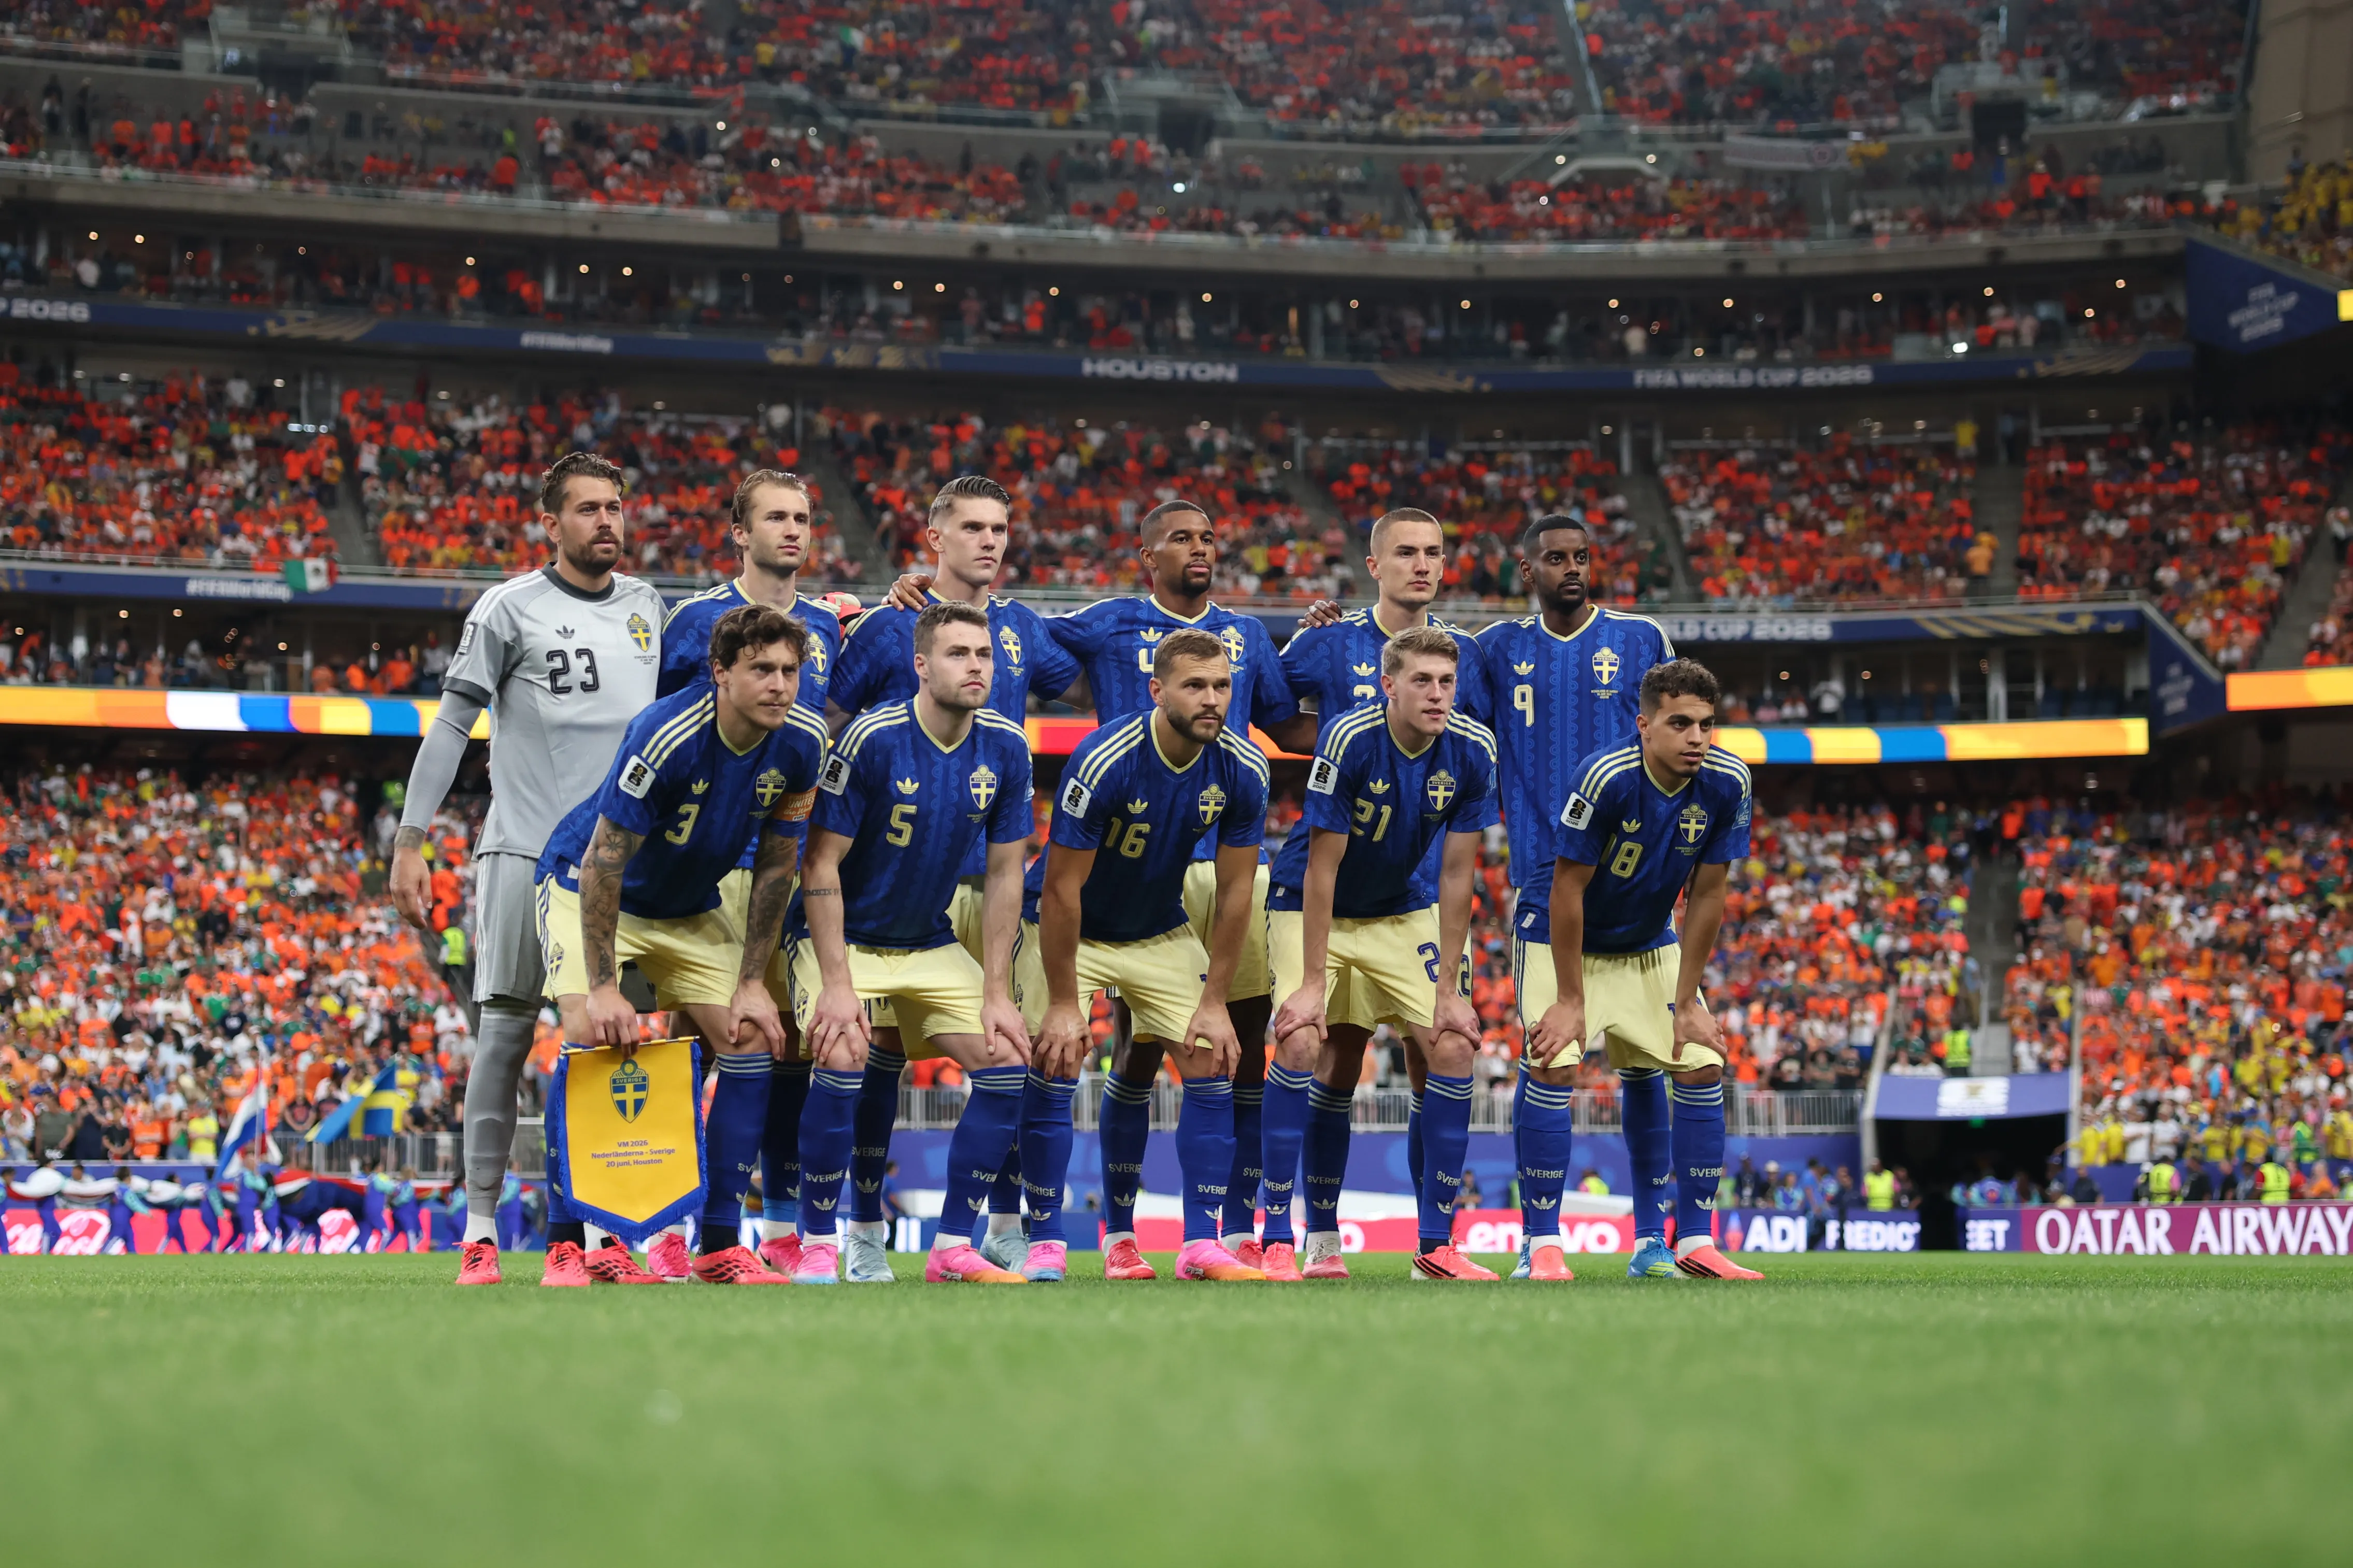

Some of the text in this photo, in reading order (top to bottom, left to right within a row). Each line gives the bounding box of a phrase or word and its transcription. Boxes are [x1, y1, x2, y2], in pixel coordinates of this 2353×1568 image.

[10, 297, 91, 322] 2026
[1081, 357, 1238, 382] HOUSTON
[1633, 364, 1874, 389] FIFA WORLD CUP 2026
[1703, 620, 1749, 640] CUP
[1751, 619, 1832, 640] 2026
[546, 648, 601, 696] 23
[1514, 684, 1534, 727] 9
[622, 783, 637, 793] 2026
[788, 794, 815, 808] UNITES
[665, 804, 700, 846] 3
[886, 804, 918, 847] 5
[1350, 797, 1393, 843] 21
[1105, 817, 1151, 859] 16
[591, 1150, 644, 1159] Nederländerna
[852, 1146, 886, 1157] SVERIGE
[805, 1170, 843, 1182] SVERIGE
[972, 1170, 998, 1182] SVER
[1243, 1167, 1262, 1178] SVER
[1307, 1175, 1341, 1185] SVERIGE
[1526, 1167, 1564, 1179] SVERIGE
[1690, 1167, 1722, 1177] SVERIG
[1022, 1178, 1056, 1197] SVERIGE
[1264, 1178, 1293, 1192] SVERIGE
[1743, 1215, 1807, 1252] ADI
[2035, 1205, 2353, 1256] QATAR AIRWAY
